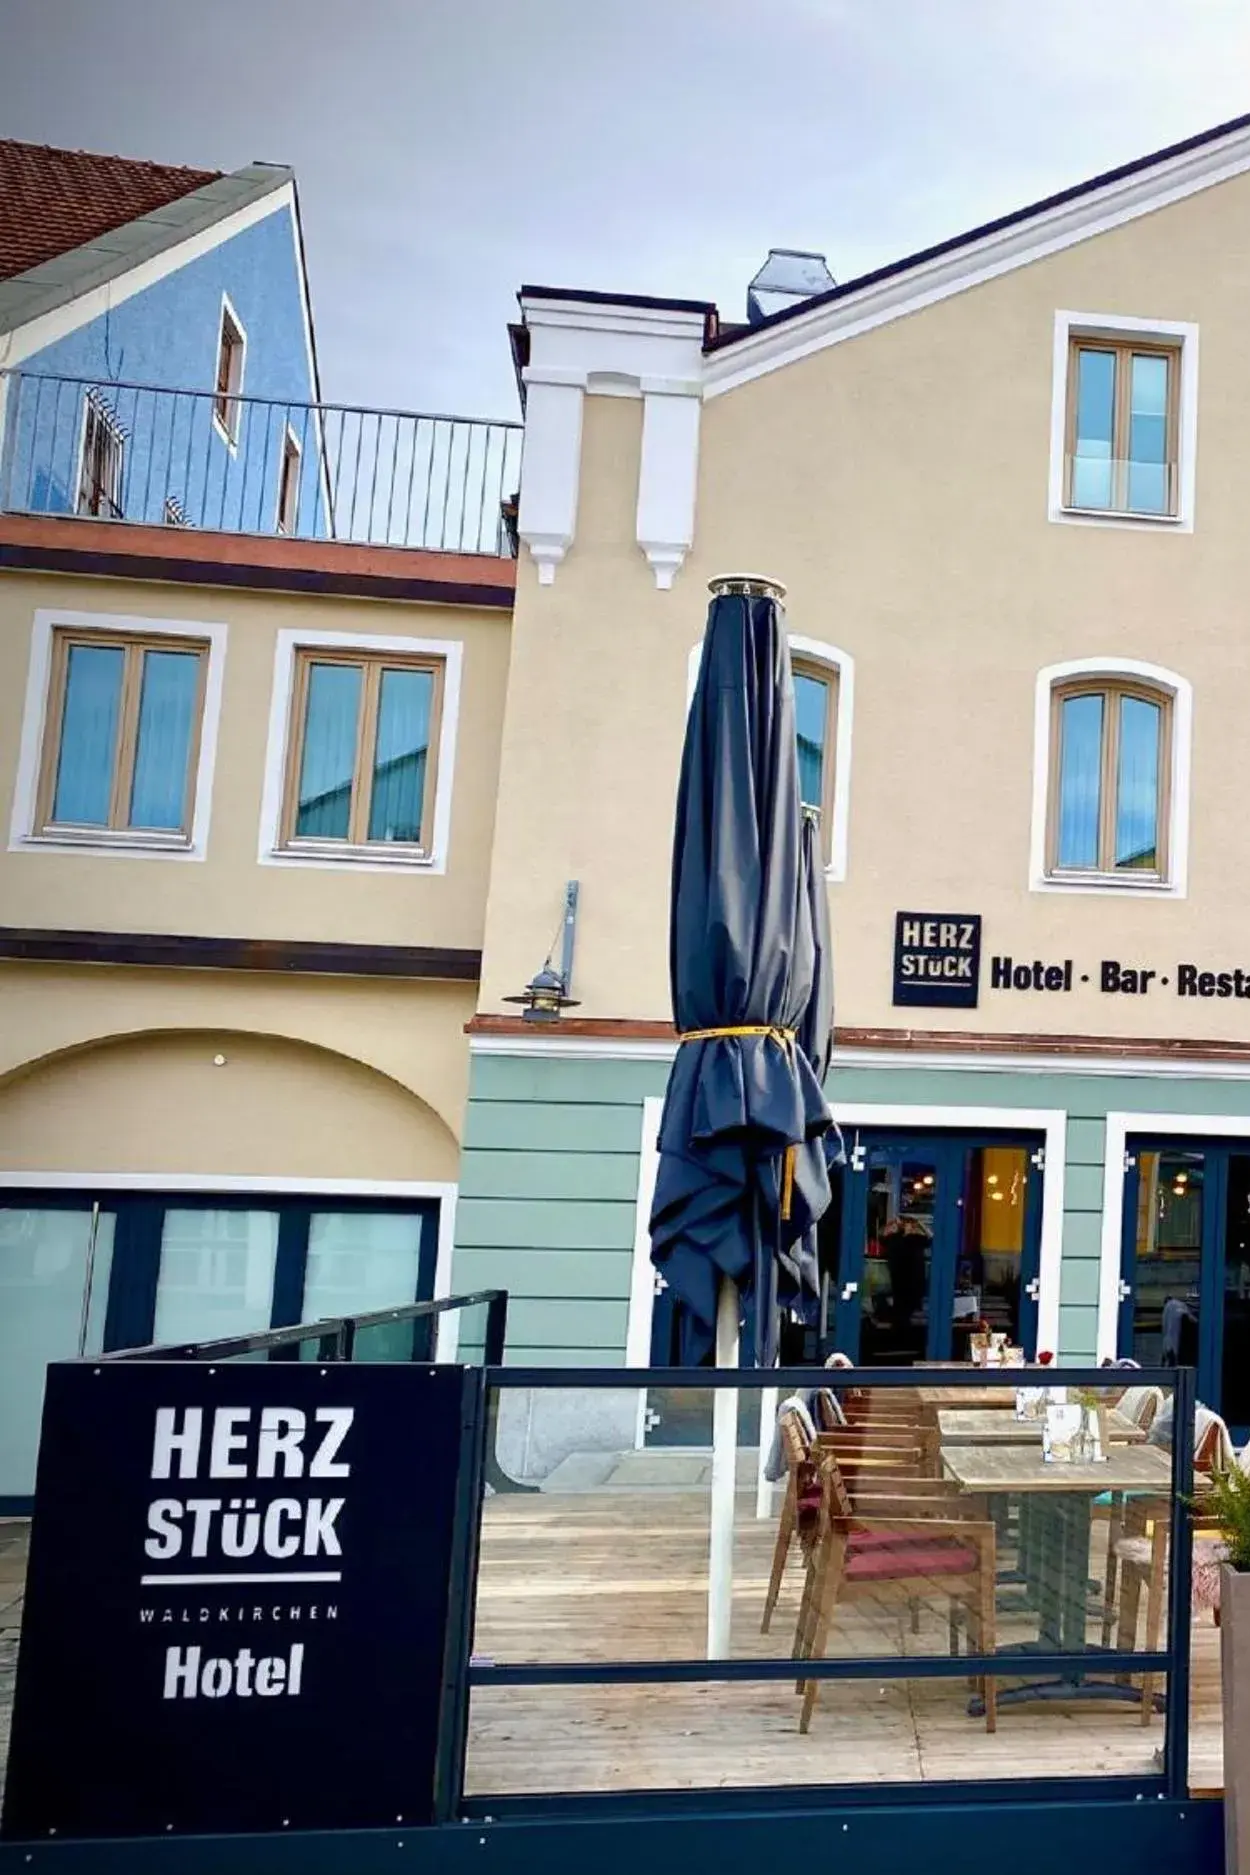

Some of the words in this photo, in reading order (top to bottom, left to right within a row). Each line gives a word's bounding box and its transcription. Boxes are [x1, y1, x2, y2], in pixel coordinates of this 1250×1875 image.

[902, 920, 974, 950] HERZ
[990, 956, 1073, 992] Hotel
[1100, 960, 1156, 995] Bar
[151, 1407, 355, 1479] HERZ
[139, 1605, 338, 1623] WALDKIRCHEN
[163, 1643, 305, 1699] Hotel
